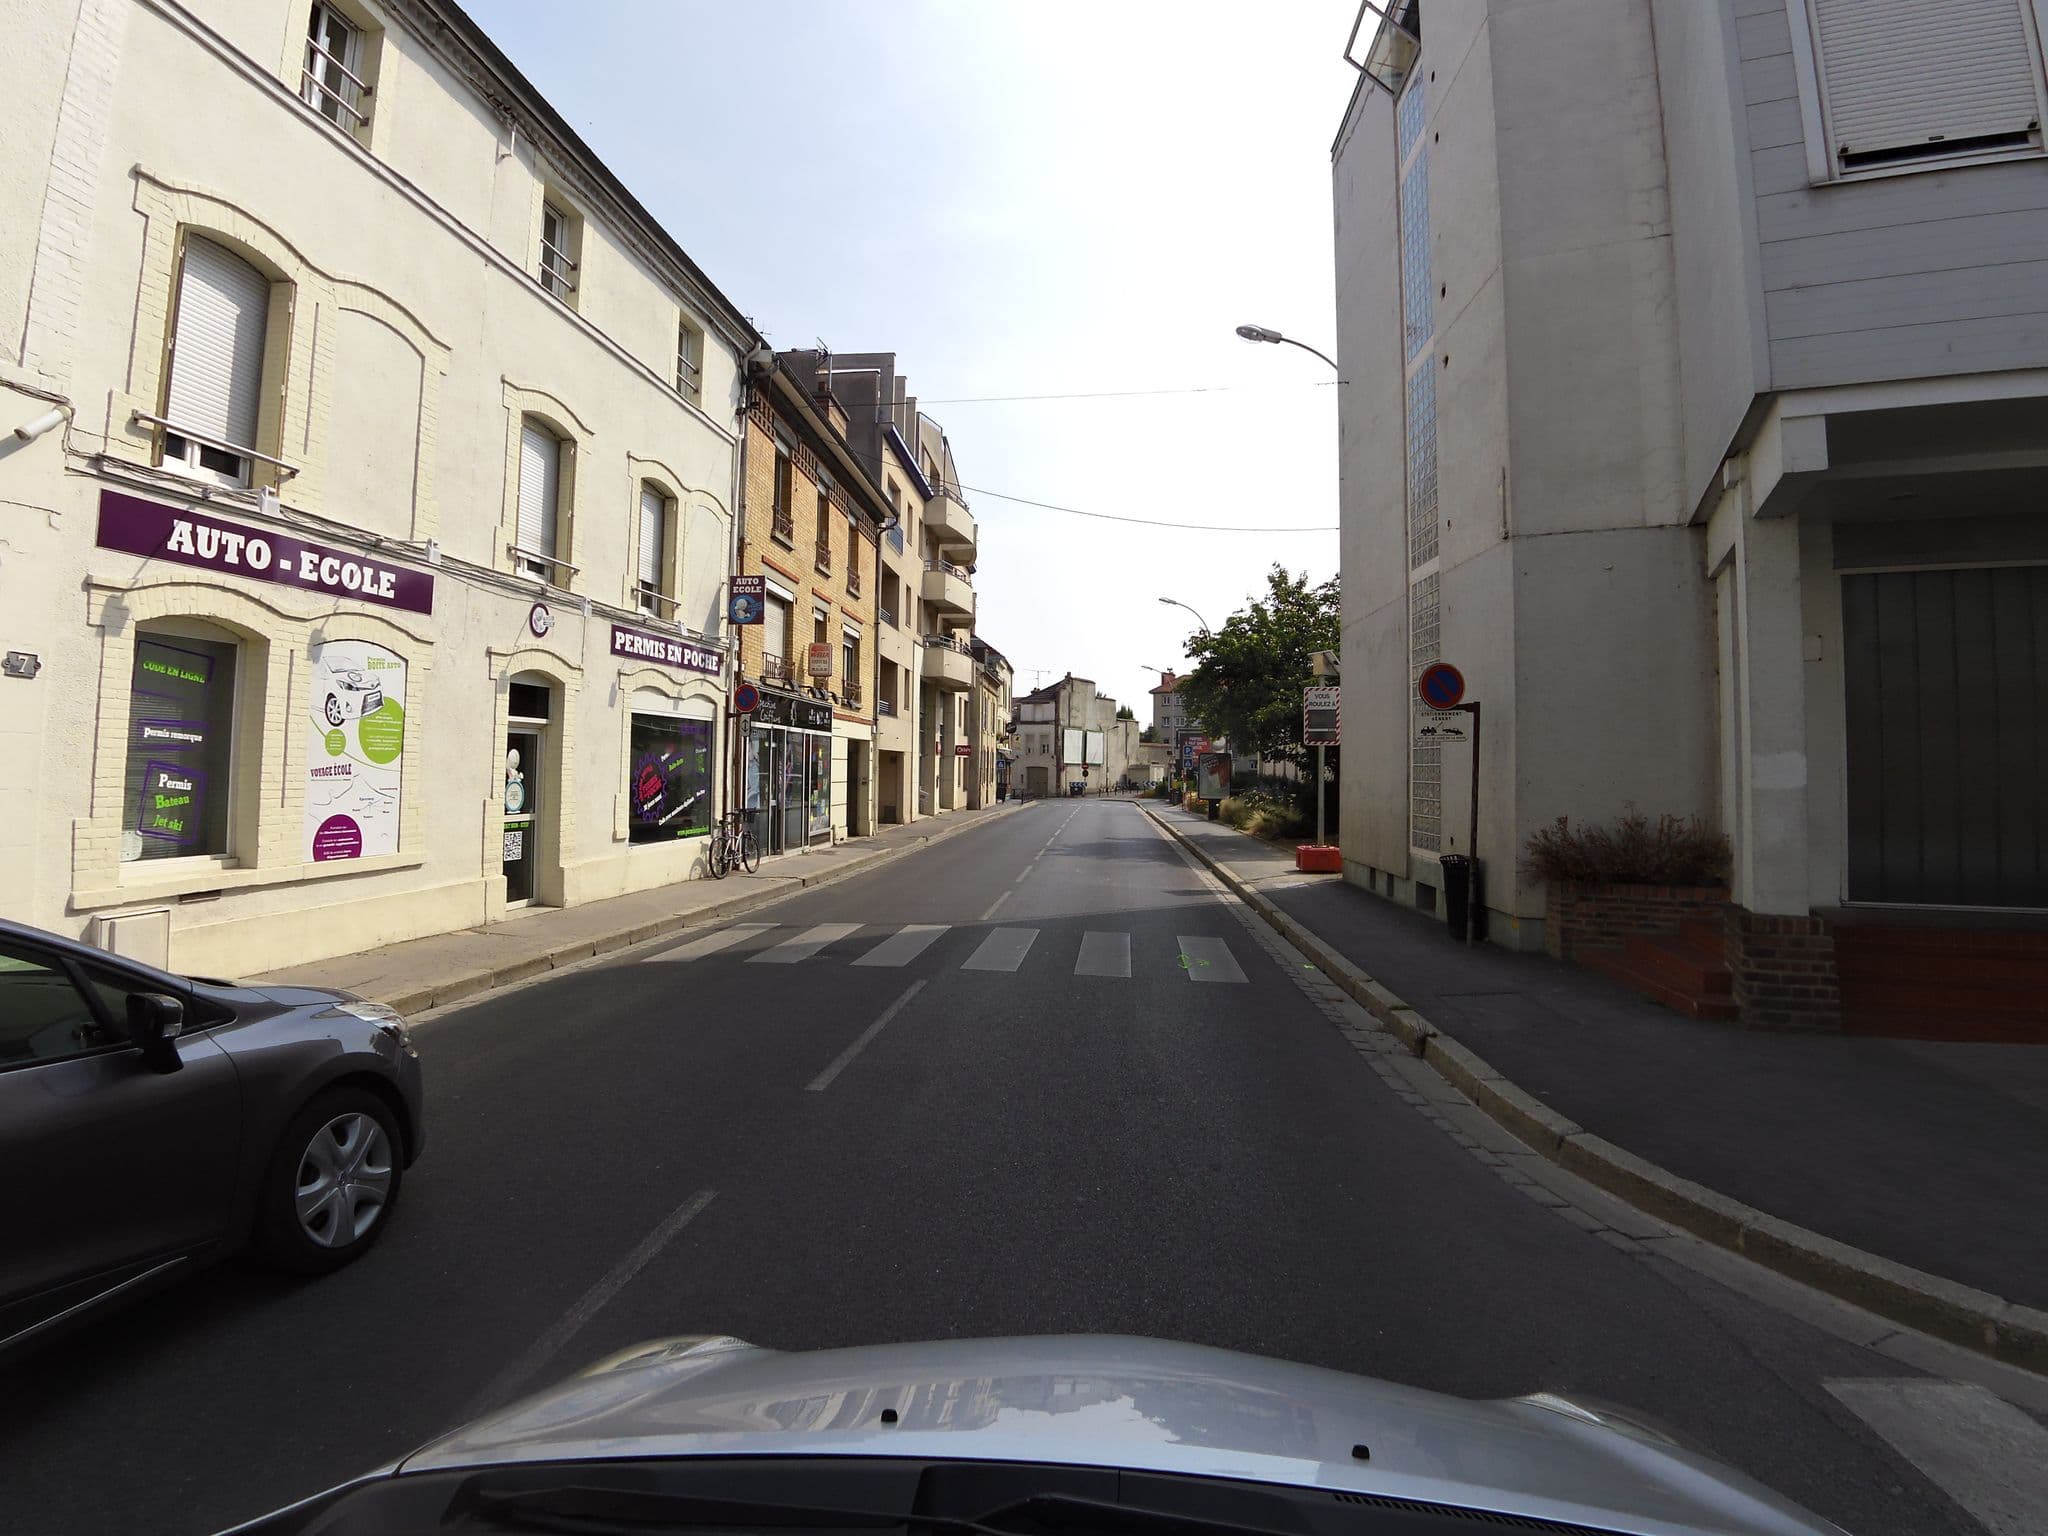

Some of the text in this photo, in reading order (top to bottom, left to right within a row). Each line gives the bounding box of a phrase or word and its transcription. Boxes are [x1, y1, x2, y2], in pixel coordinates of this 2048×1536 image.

[166, 519, 272, 570] AUTO
[299, 550, 397, 600] ECOLE
[735, 577, 759, 585] AUTO
[614, 631, 719, 672] PERMIS EN POCHE
[17, 655, 28, 673] 7
[166, 666, 179, 677] EN
[143, 727, 203, 743] Permis remorque
[310, 762, 352, 777] VOYAGE ÉCOLE
[158, 773, 192, 791] Permis
[155, 794, 190, 809] Bateau
[153, 814, 183, 832] Jet ski
